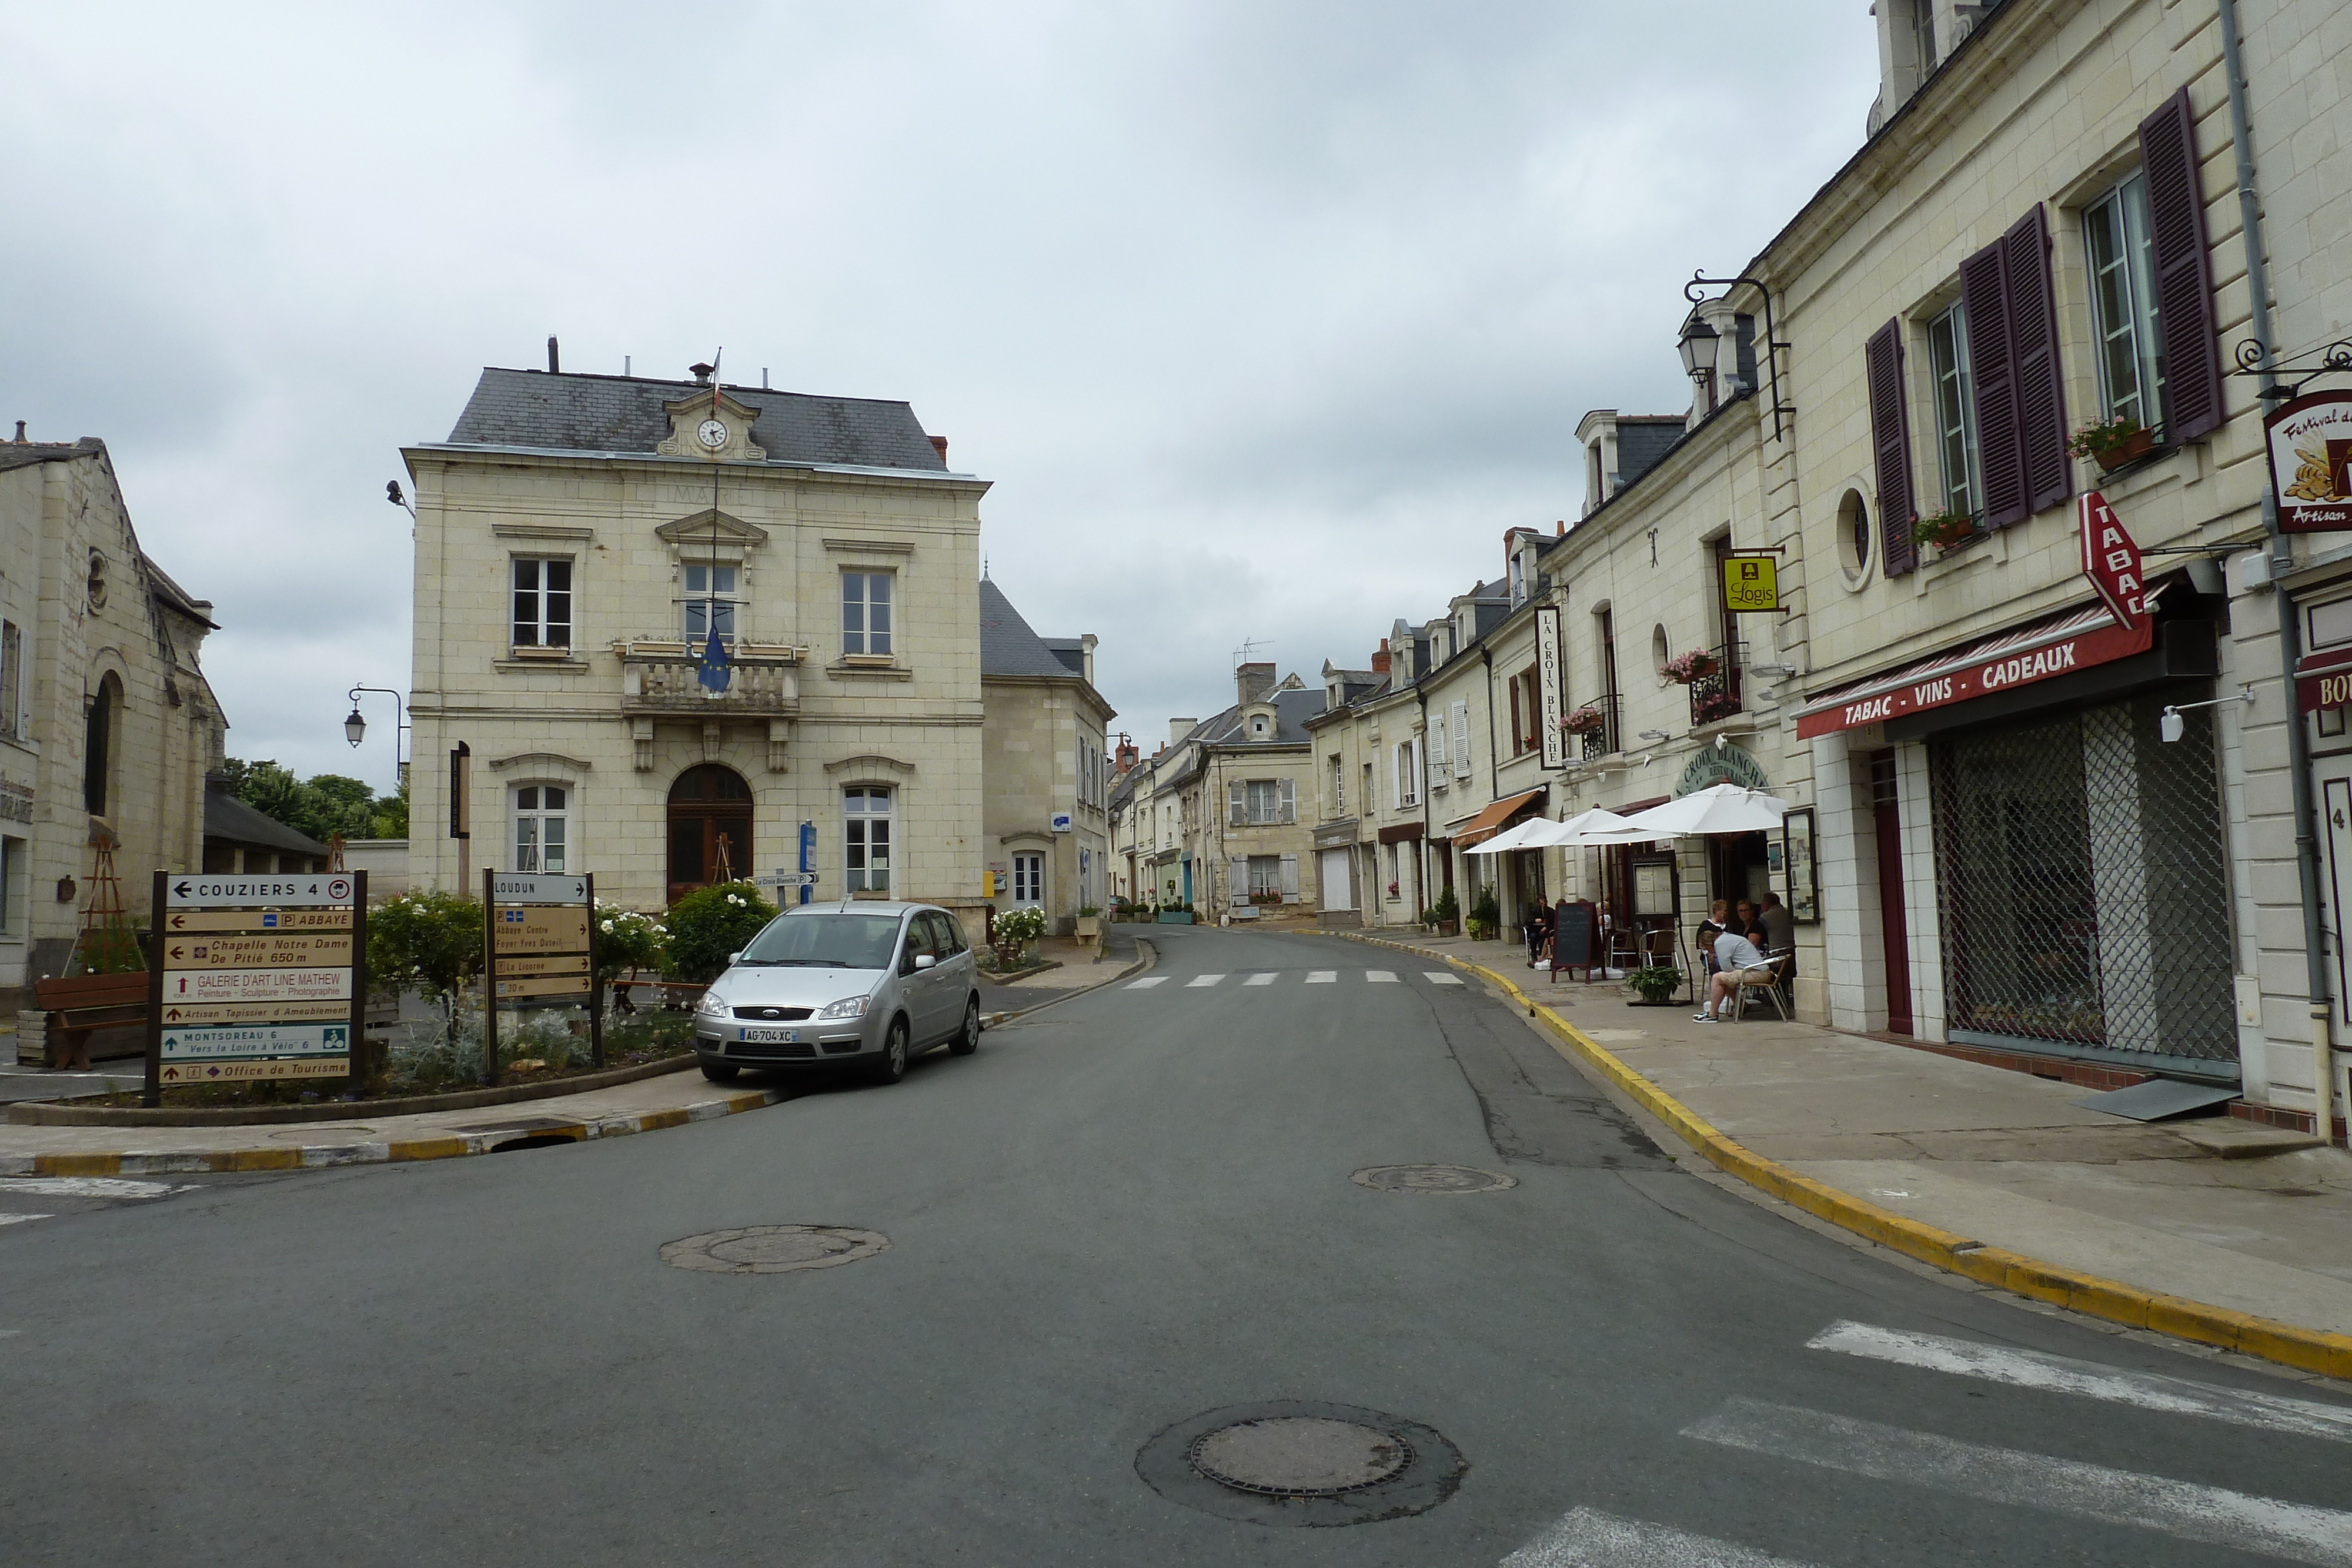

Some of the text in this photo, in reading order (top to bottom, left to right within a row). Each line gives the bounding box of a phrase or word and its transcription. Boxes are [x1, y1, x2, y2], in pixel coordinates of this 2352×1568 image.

[2283, 409, 2337, 440] Festival
[2292, 506, 2347, 524] Artisan
[2095, 506, 2143, 615] TABAC
[1730, 581, 1773, 605] Logis
[1544, 616, 1557, 762] LA CROIX BLANCHE
[1845, 696, 1892, 724] TABAC
[1915, 677, 1952, 706] VINS
[1982, 642, 2075, 688] CADEAUX
[1684, 747, 1711, 783] CROIX
[1709, 765, 1747, 786] RESTAURANT
[2333, 808, 2344, 829] 4
[199, 884, 318, 896] COUZIERS 4
[495, 882, 535, 893] LOUDUN
[299, 915, 348, 925] ABBAYE
[496, 925, 548, 935] Abbaye Centre
[212, 940, 348, 952] Chapelle Notre Dame
[496, 938, 562, 950] Foyer Yves Duteil
[211, 954, 226, 963] De
[234, 953, 263, 963] Pitié
[270, 953, 293, 962] 650
[507, 962, 544, 971] La Licorne
[198, 974, 340, 987] GALERIE D'ART LINE MATHEW
[198, 989, 231, 998] Peinture
[241, 988, 278, 998] Sculpture
[288, 987, 340, 997] Photographie
[507, 984, 517, 992] 30
[185, 1010, 219, 1018] Artisan
[226, 1008, 267, 1018] Tapissier
[184, 1032, 263, 1041] MONTSOREAU
[747, 1031, 790, 1041] AG-704-XC
[262, 1042, 267, 1051] à
[225, 1064, 346, 1076] Office de Tourisme
